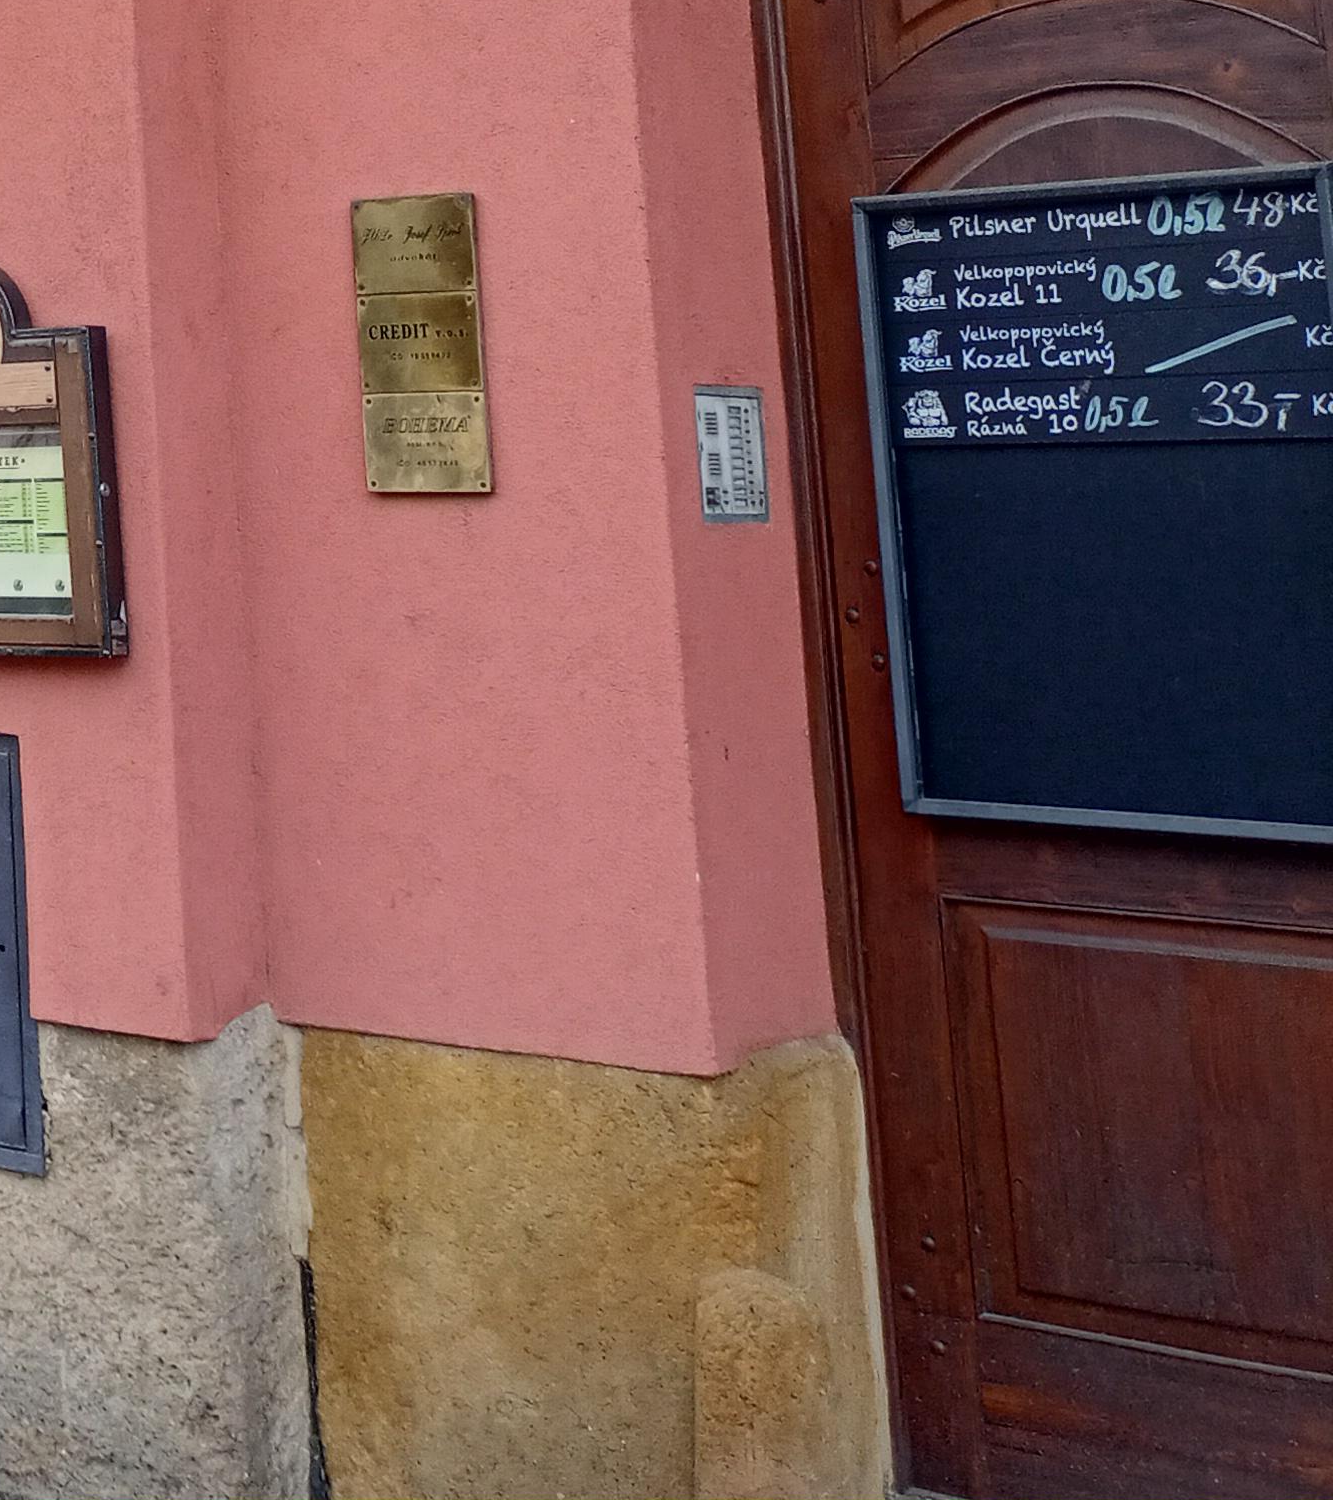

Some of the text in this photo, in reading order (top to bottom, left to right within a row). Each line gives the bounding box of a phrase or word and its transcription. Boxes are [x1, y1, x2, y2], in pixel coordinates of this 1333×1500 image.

[948, 214, 1037, 238] Pilsner
[1048, 203, 1142, 242] Urquell
[1290, 192, 1320, 215] Kč
[953, 257, 1097, 286] Velkopopovický
[1297, 258, 1328, 282] Kč
[893, 293, 948, 312] Kozel
[955, 283, 1063, 310] Kozel 11
[368, 323, 429, 340] CREDIT
[959, 319, 1105, 348] Velkopopovický
[899, 354, 954, 373] Kozel
[962, 337, 1116, 374] Kozel Černý
[965, 386, 1081, 420] Radegast
[967, 413, 1079, 437] Rázná 10
